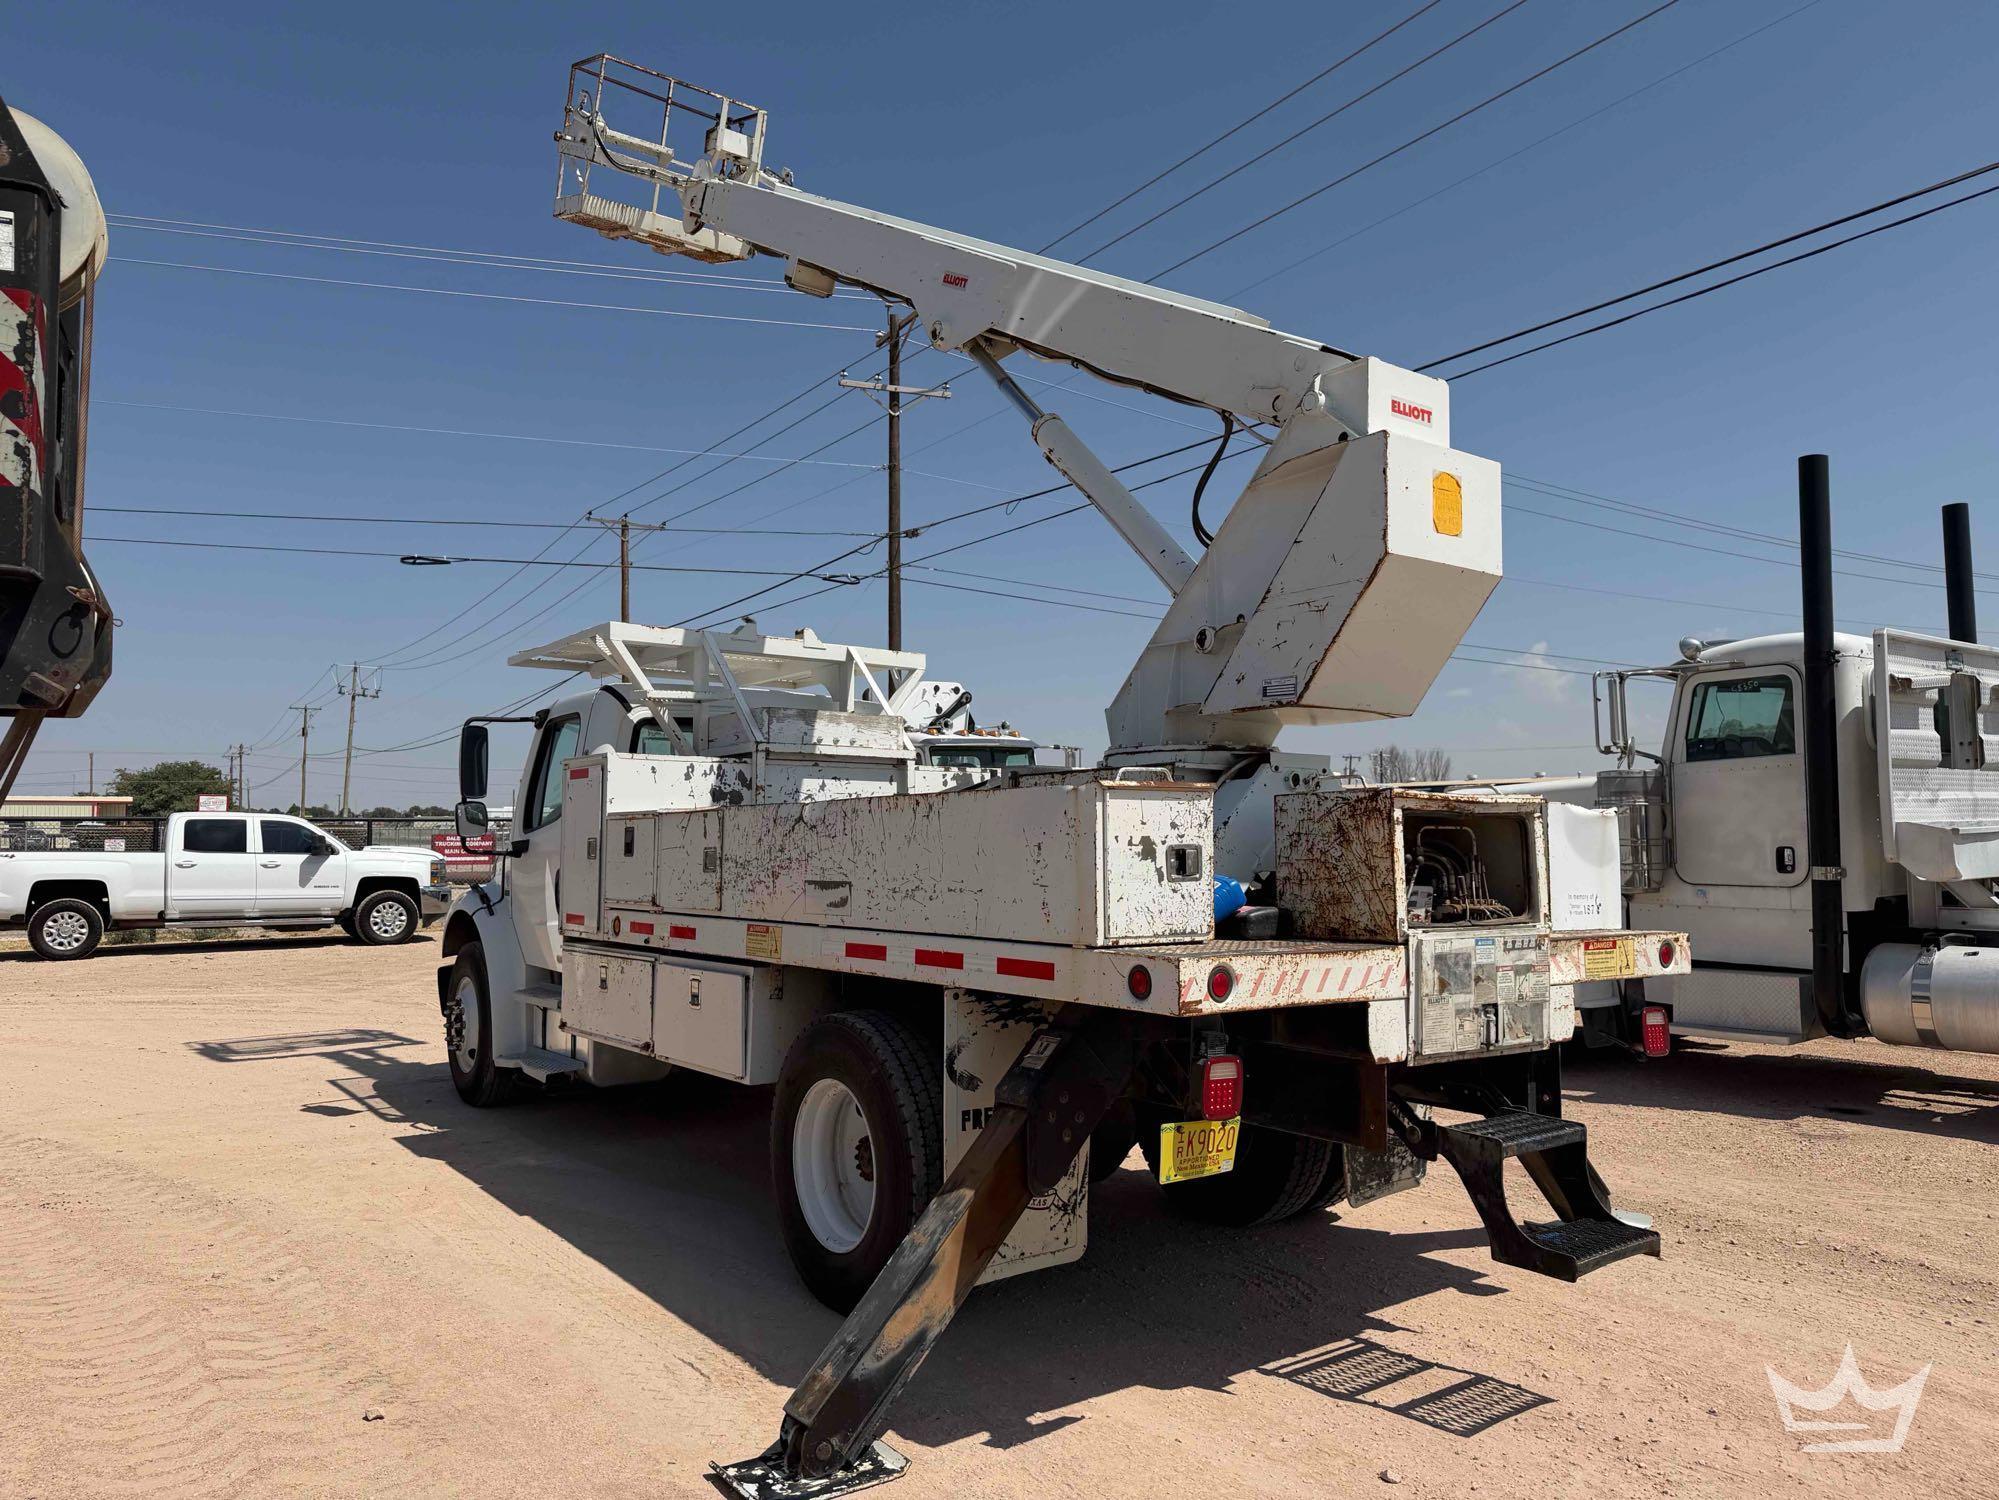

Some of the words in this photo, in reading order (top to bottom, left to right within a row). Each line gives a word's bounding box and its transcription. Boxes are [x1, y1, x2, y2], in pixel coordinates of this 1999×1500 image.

[943, 272, 969, 288] ELLIOTT
[1391, 399, 1433, 424] ELLIOTT
[1593, 941, 1614, 949] DANGER
[1186, 1125, 1236, 1157] K9020
[1179, 1154, 1220, 1165] APPORTIONED
